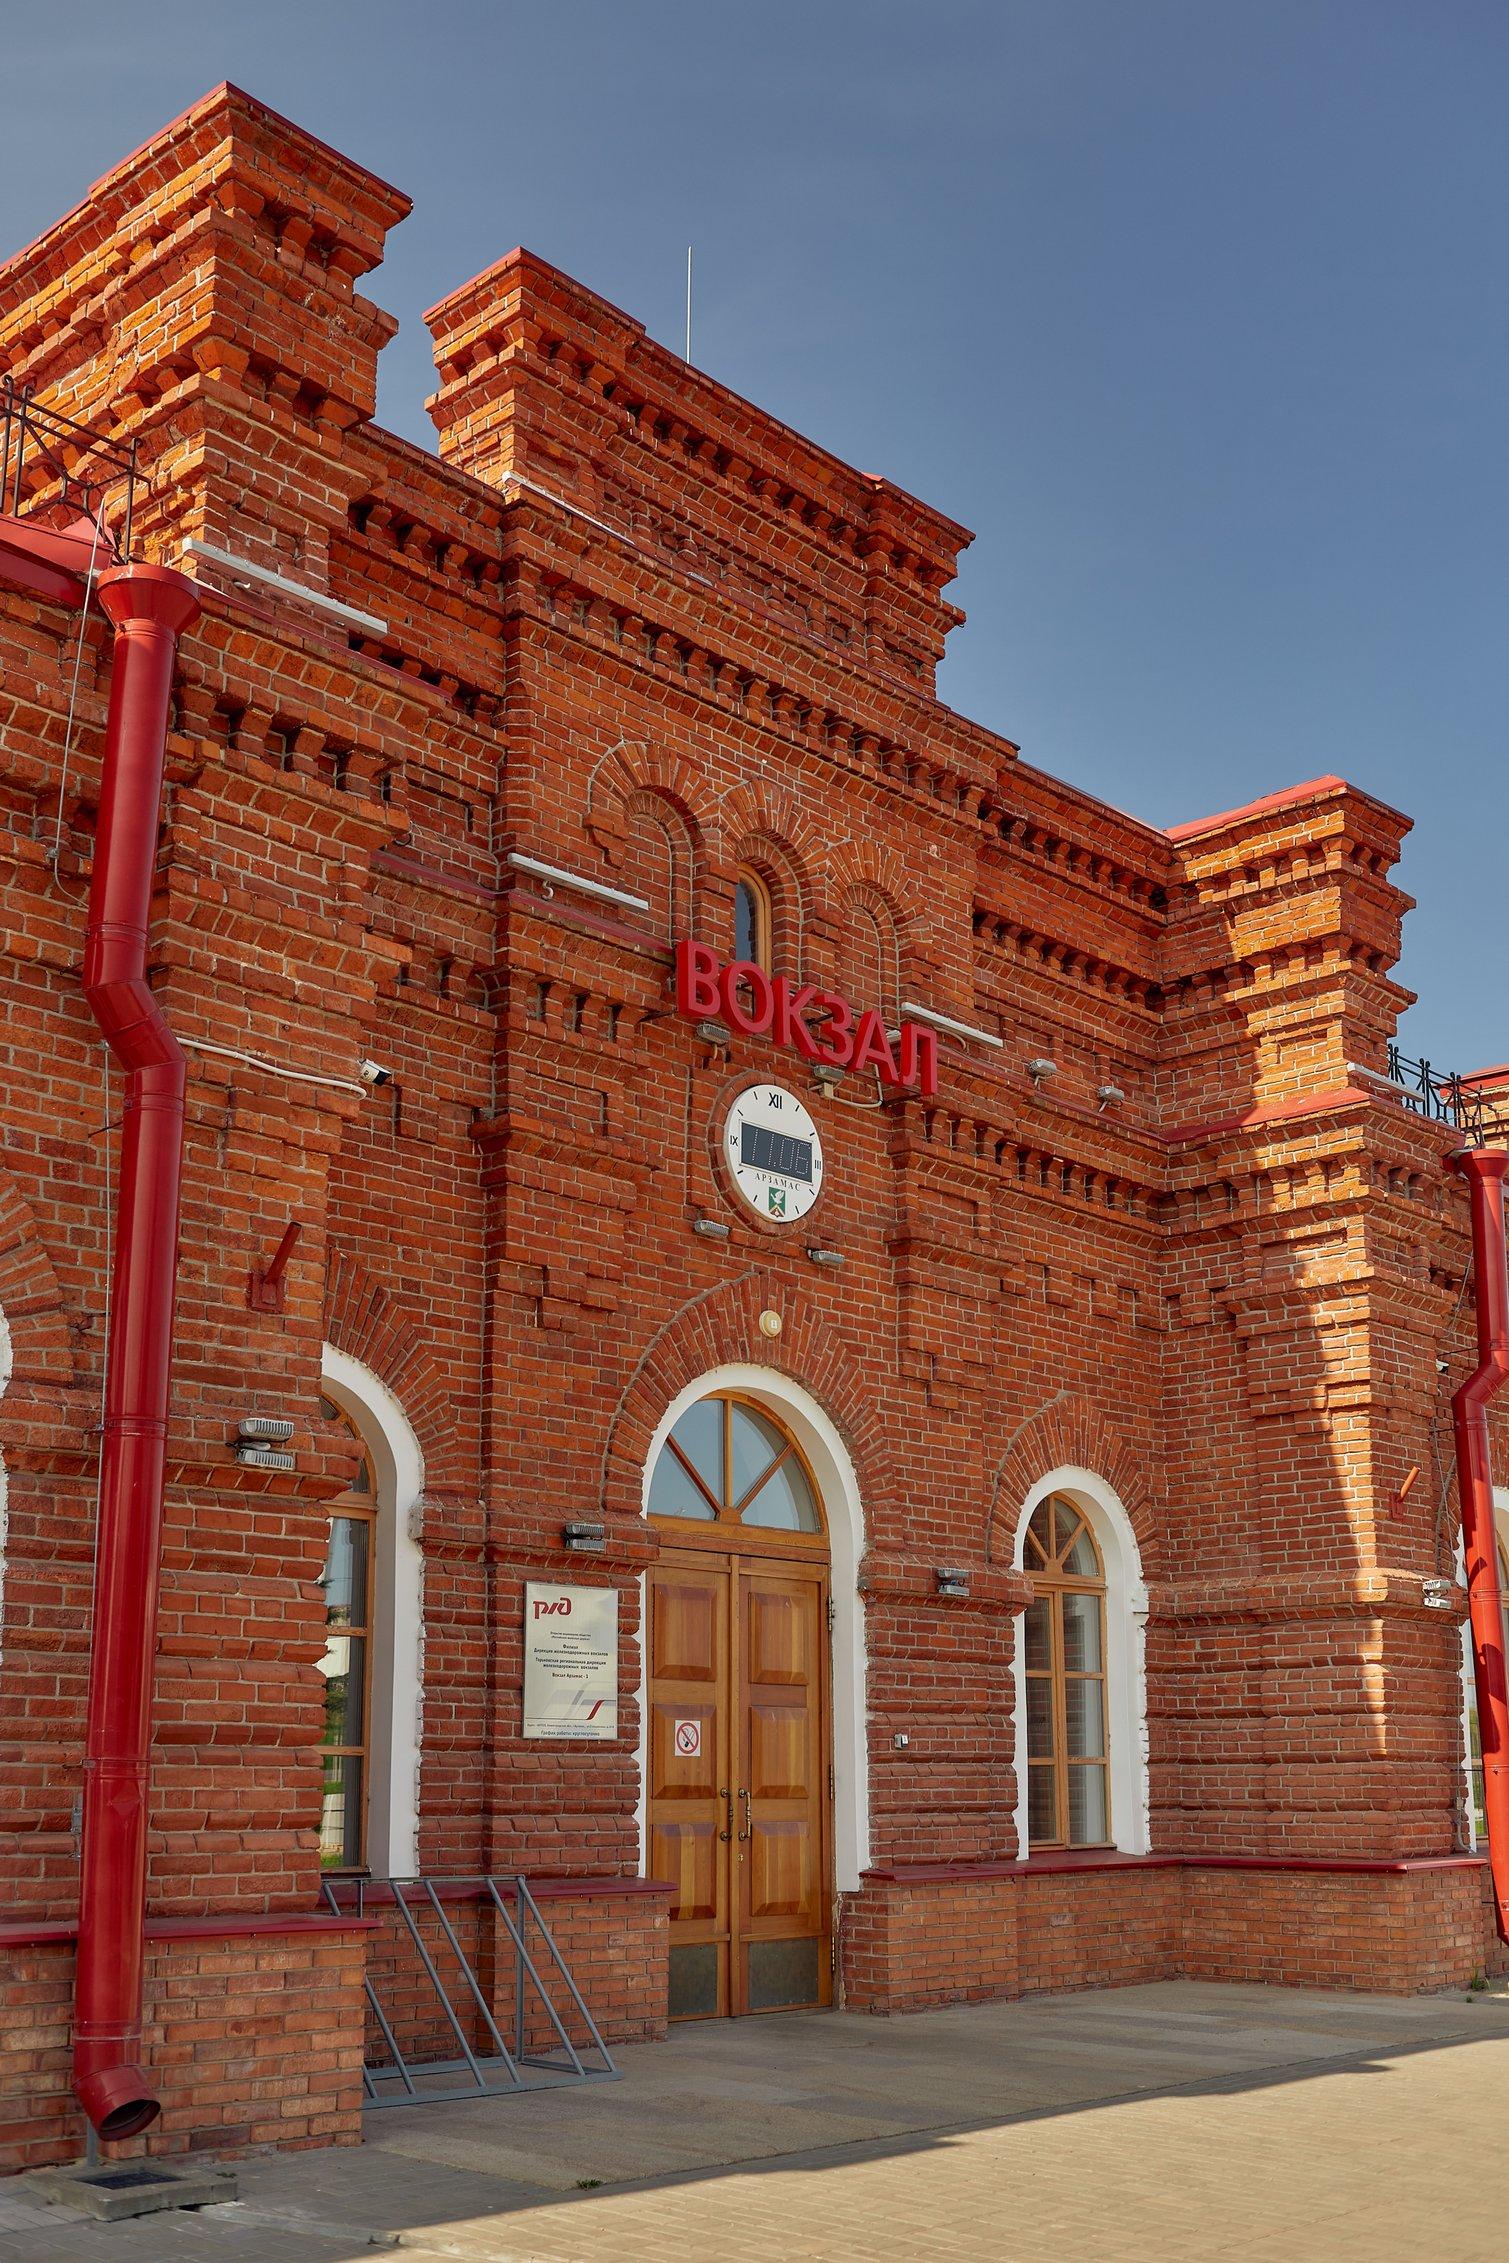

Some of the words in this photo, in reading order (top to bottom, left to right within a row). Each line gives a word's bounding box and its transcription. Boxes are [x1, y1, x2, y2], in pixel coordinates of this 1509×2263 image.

[677, 940, 937, 1096] ВОКЗАЛ
[768, 1092, 783, 1109] XII
[729, 1135, 739, 1147] IX
[754, 1172, 801, 1192] АРЗАМАС
